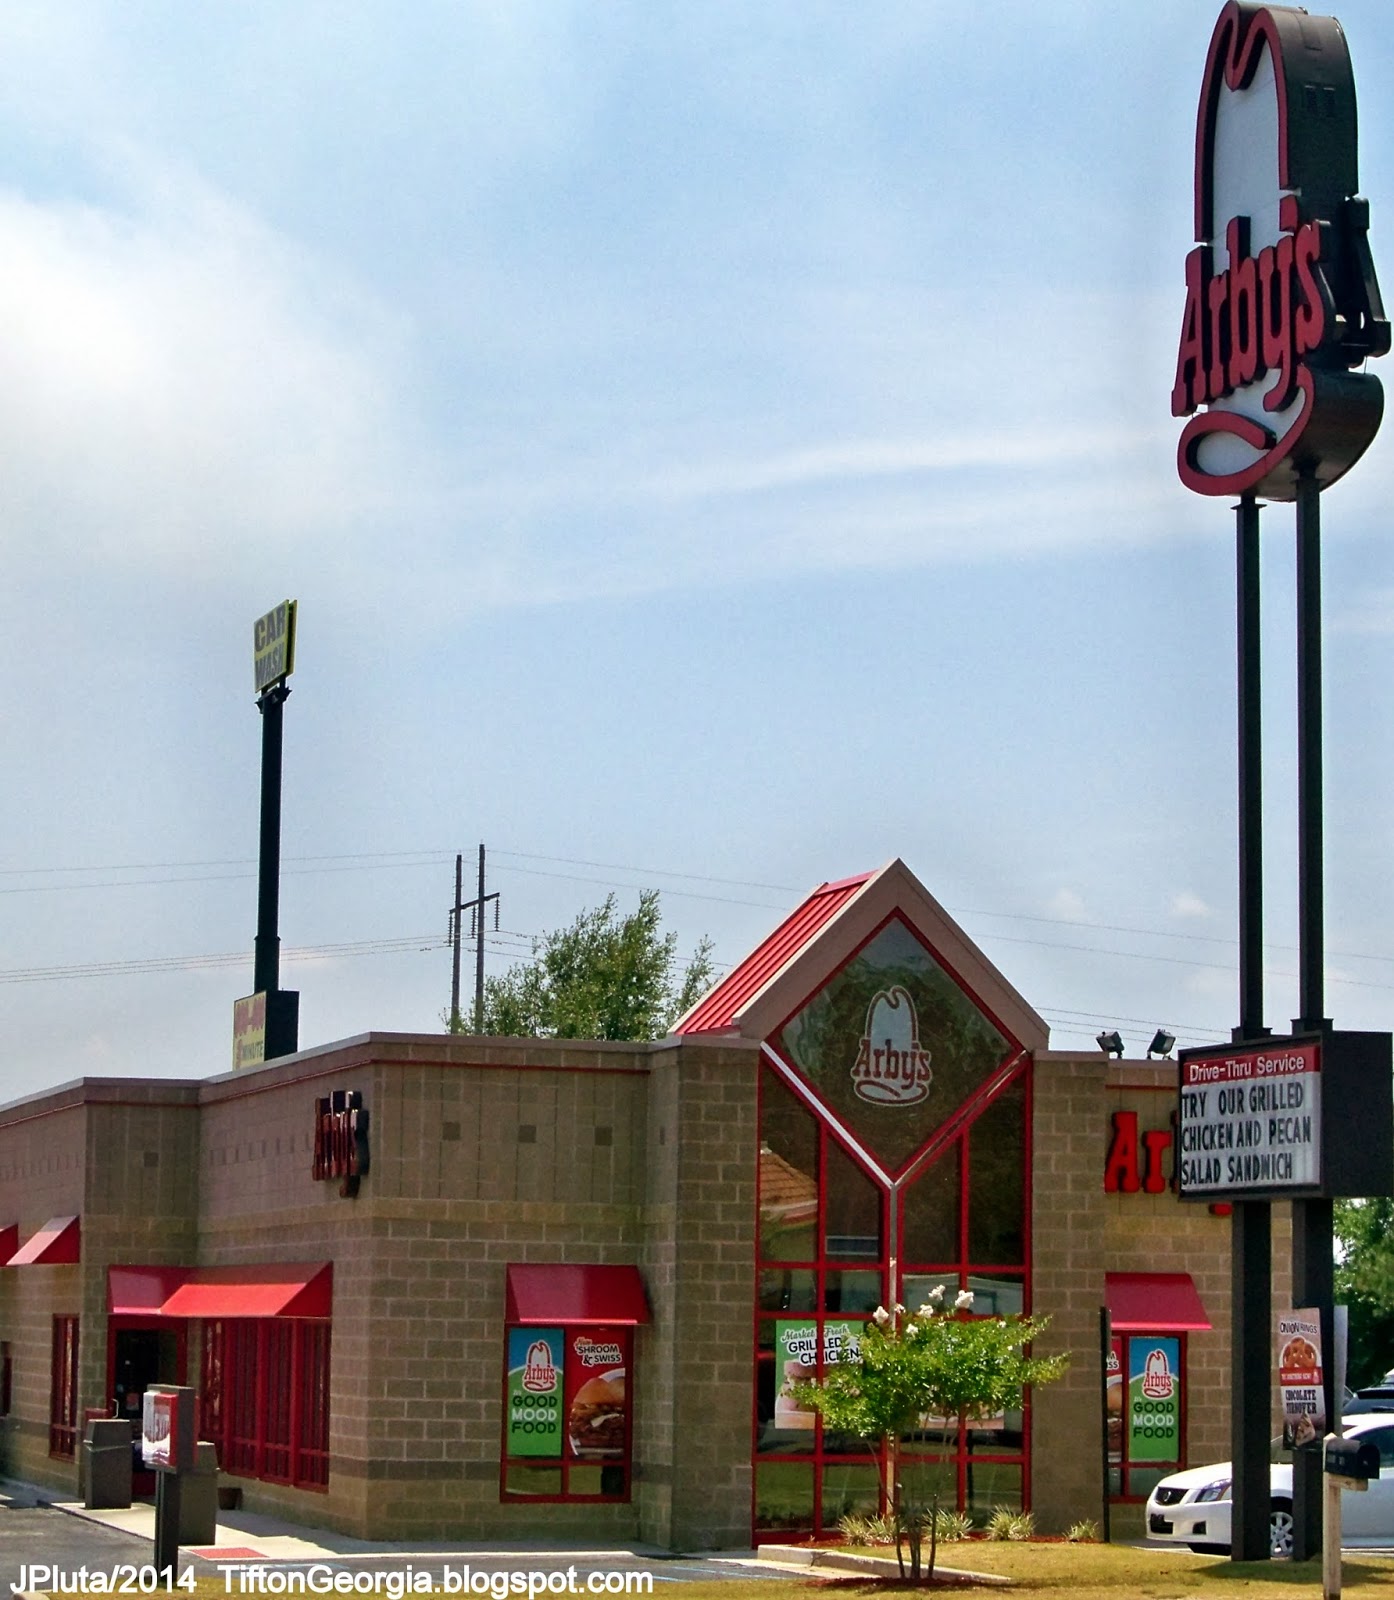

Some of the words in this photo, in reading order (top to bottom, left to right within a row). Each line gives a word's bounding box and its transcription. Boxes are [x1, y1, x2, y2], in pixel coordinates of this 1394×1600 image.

[1172, 195, 1325, 417] Arby's
[255, 604, 286, 652] CAR
[852, 1039, 931, 1090] Arby's
[1190, 1060, 1251, 1082] Drive-Thru
[1257, 1054, 1304, 1075] Service
[1182, 1092, 1207, 1118] TRY
[1218, 1087, 1245, 1115] OUR
[1249, 1081, 1304, 1112] GRILLED
[1182, 1122, 1233, 1151] CHICKEN
[1236, 1120, 1261, 1147] AND
[1269, 1116, 1311, 1145] PECAN
[1182, 1158, 1221, 1185] SALAD
[1228, 1153, 1292, 1182] SANDWICH
[782, 1329, 815, 1341] Market
[824, 1325, 848, 1337] Fresh
[1280, 1322, 1299, 1334] ONION
[1300, 1323, 1317, 1334] RINGS
[583, 1354, 593, 1365] &
[594, 1354, 621, 1362] SWISS
[524, 1364, 555, 1384] Arby's
[1143, 1371, 1172, 1390] Arby's
[512, 1395, 558, 1407] GOOD
[1133, 1402, 1175, 1413] GOOD
[511, 1408, 557, 1421] MOOD
[1133, 1414, 1174, 1426] MOOD
[511, 1422, 557, 1434] FOOD
[1133, 1427, 1174, 1438] FOOD
